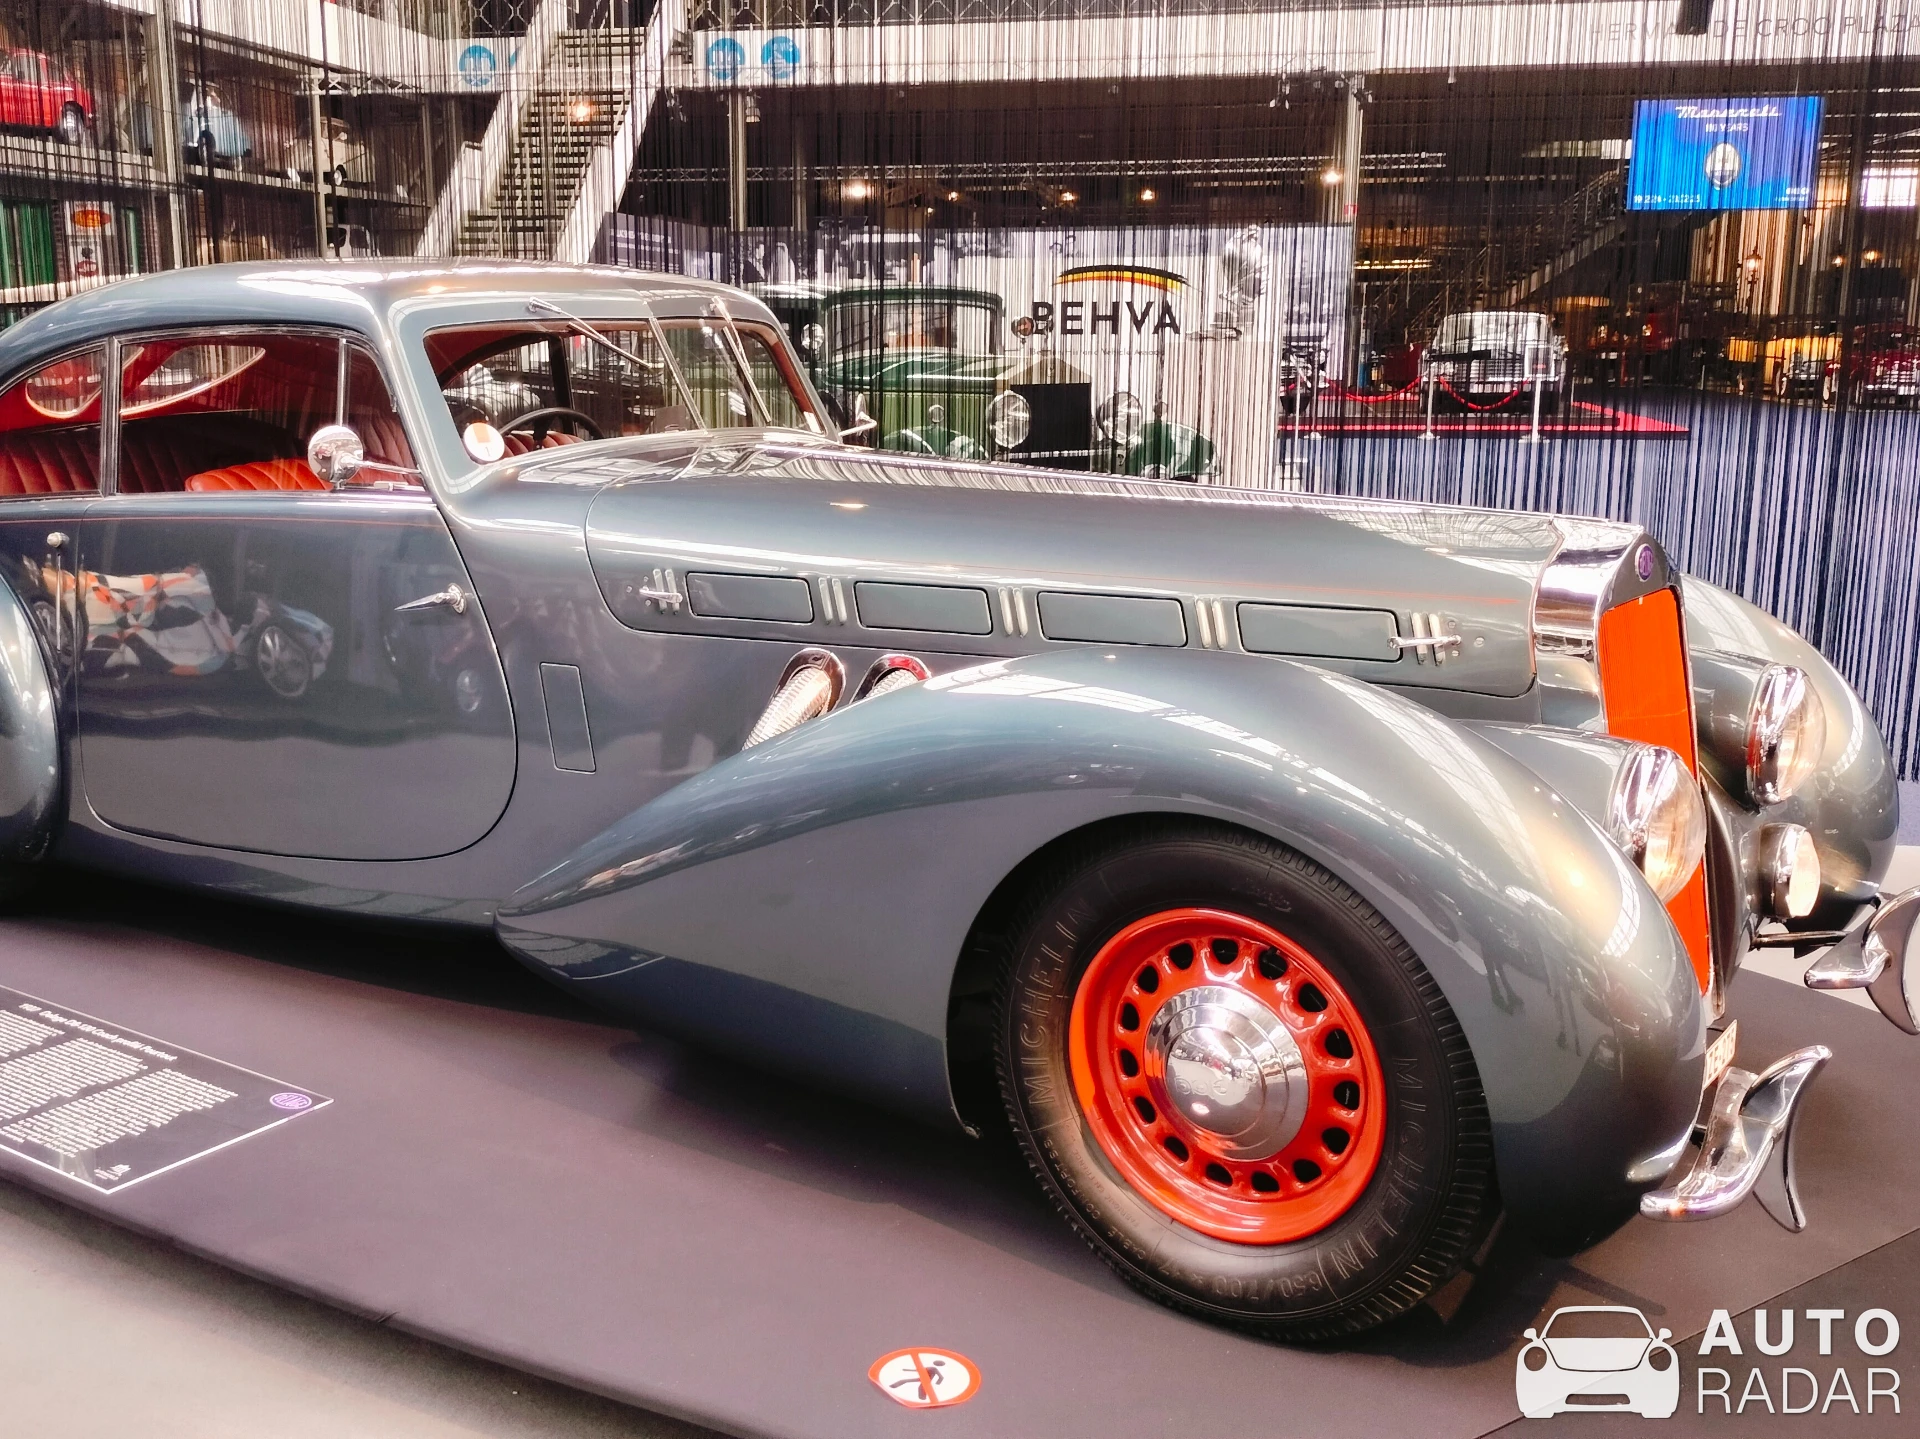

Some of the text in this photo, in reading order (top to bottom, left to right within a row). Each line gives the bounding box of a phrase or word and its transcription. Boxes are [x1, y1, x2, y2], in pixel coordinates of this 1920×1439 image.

[1590, 20, 1700, 42] HERMA
[1713, 20, 1748, 38] DE
[1719, 122, 1749, 132] YEARS
[1032, 301, 1181, 335] BEHVA
[1020, 899, 1098, 1105] MICHELIN
[1330, 1057, 1428, 1270] MICHELIN
